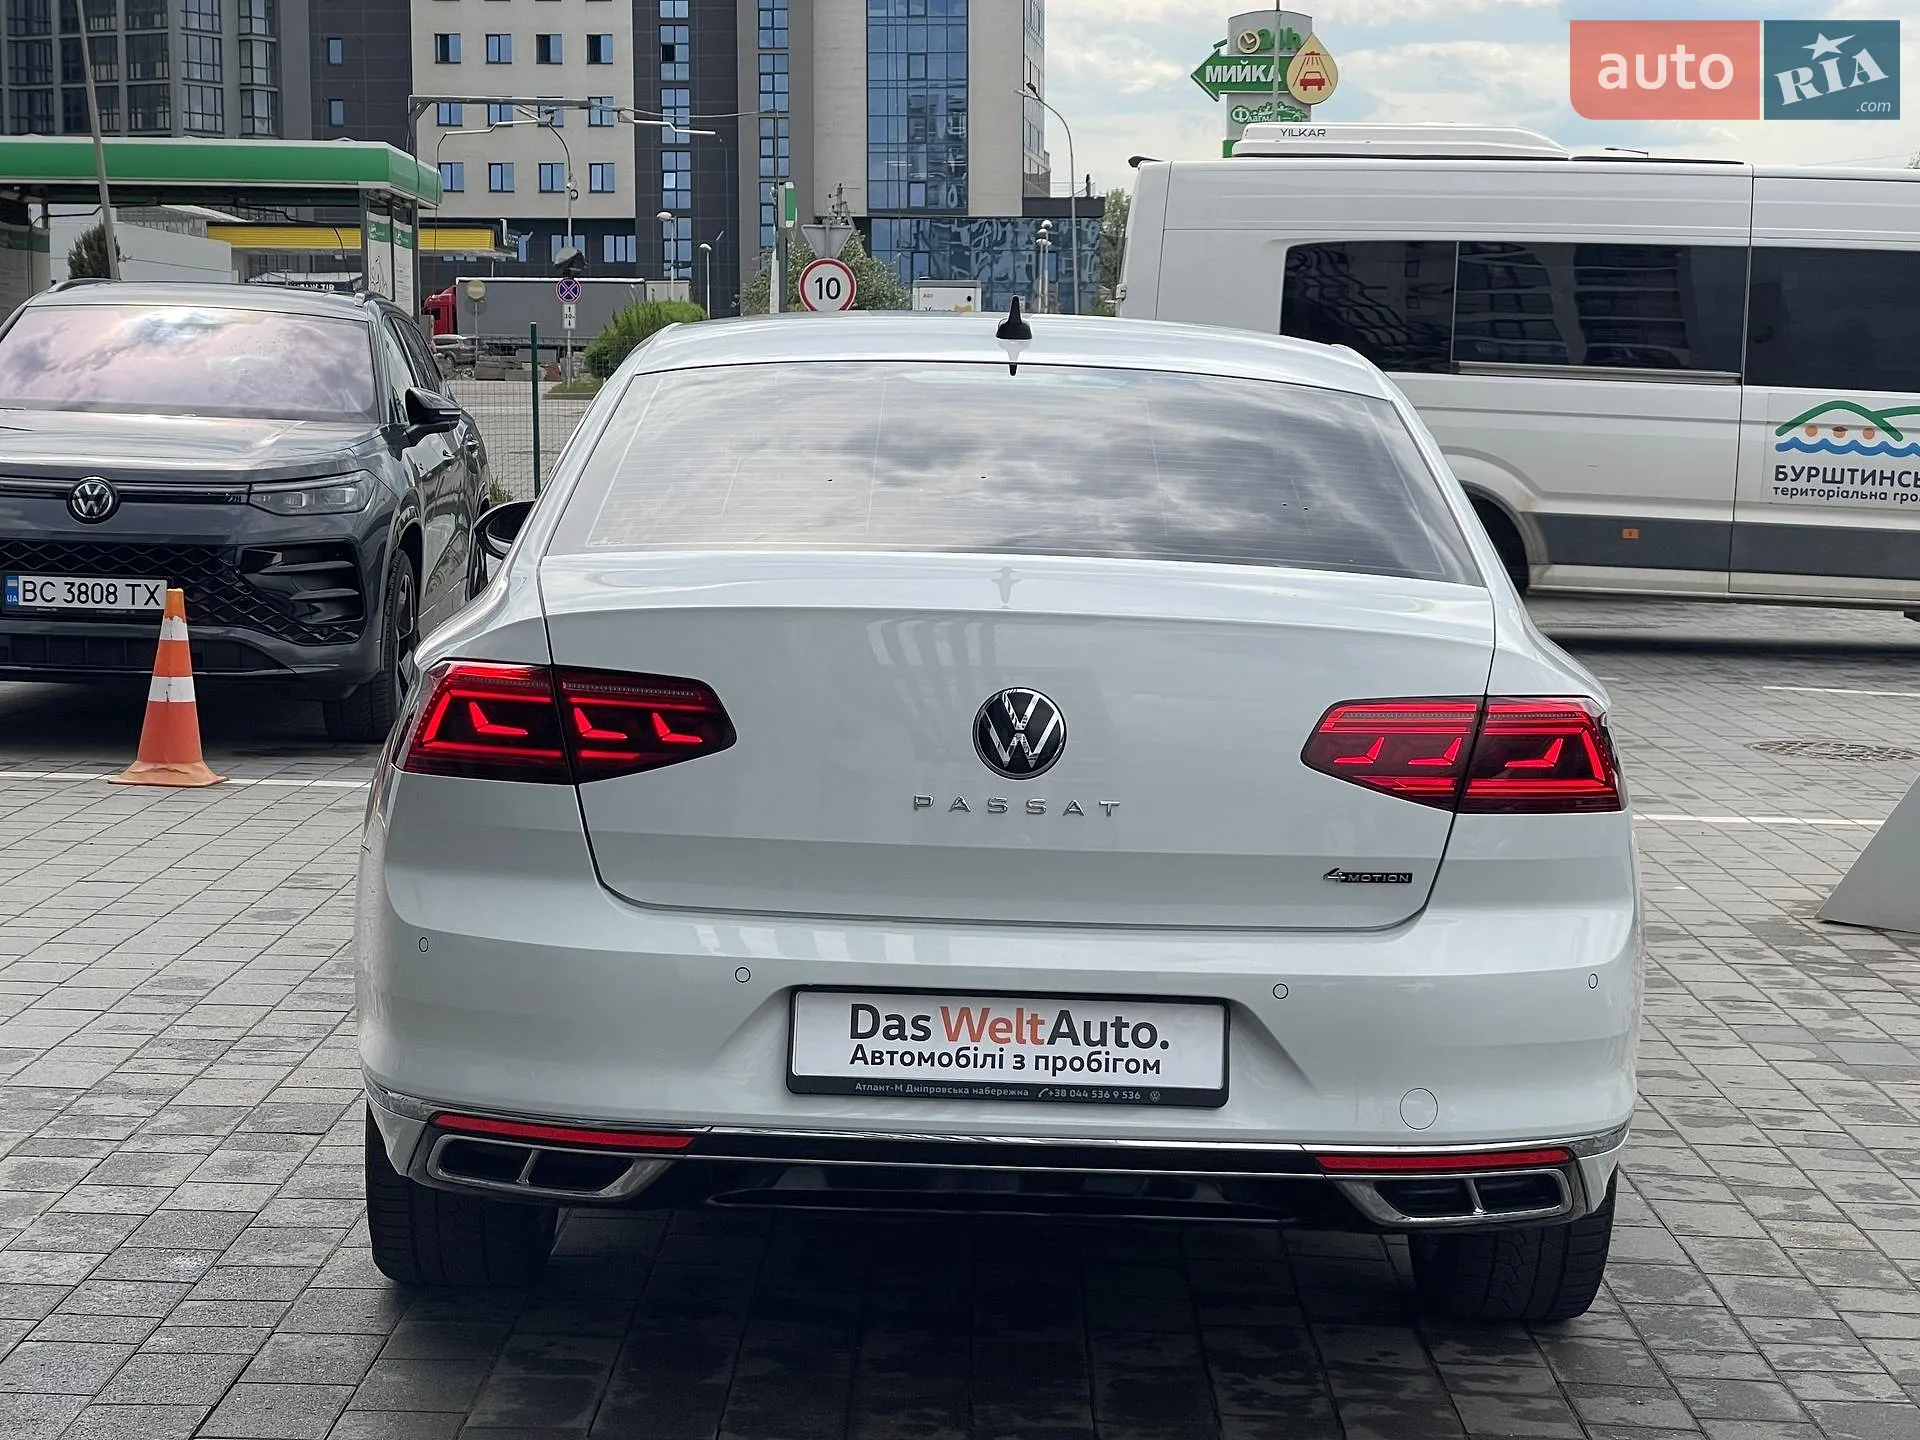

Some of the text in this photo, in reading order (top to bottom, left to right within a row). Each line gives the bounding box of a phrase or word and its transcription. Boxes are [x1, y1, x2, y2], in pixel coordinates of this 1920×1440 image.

[1280, 128, 1327, 137] YILKAR
[814, 277, 841, 300] 10
[1773, 486, 1920, 504] територіальна гро
[22, 580, 161, 606] BC 3808 TX
[913, 794, 1121, 817] PASSAT
[850, 1003, 932, 1042] Das
[849, 1043, 1161, 1077] Автомобілі з пробігом
[855, 1082, 1029, 1097] Атлант-М Дніпровська набережна
[1048, 1088, 1141, 1100] +38 044 536 9 536
